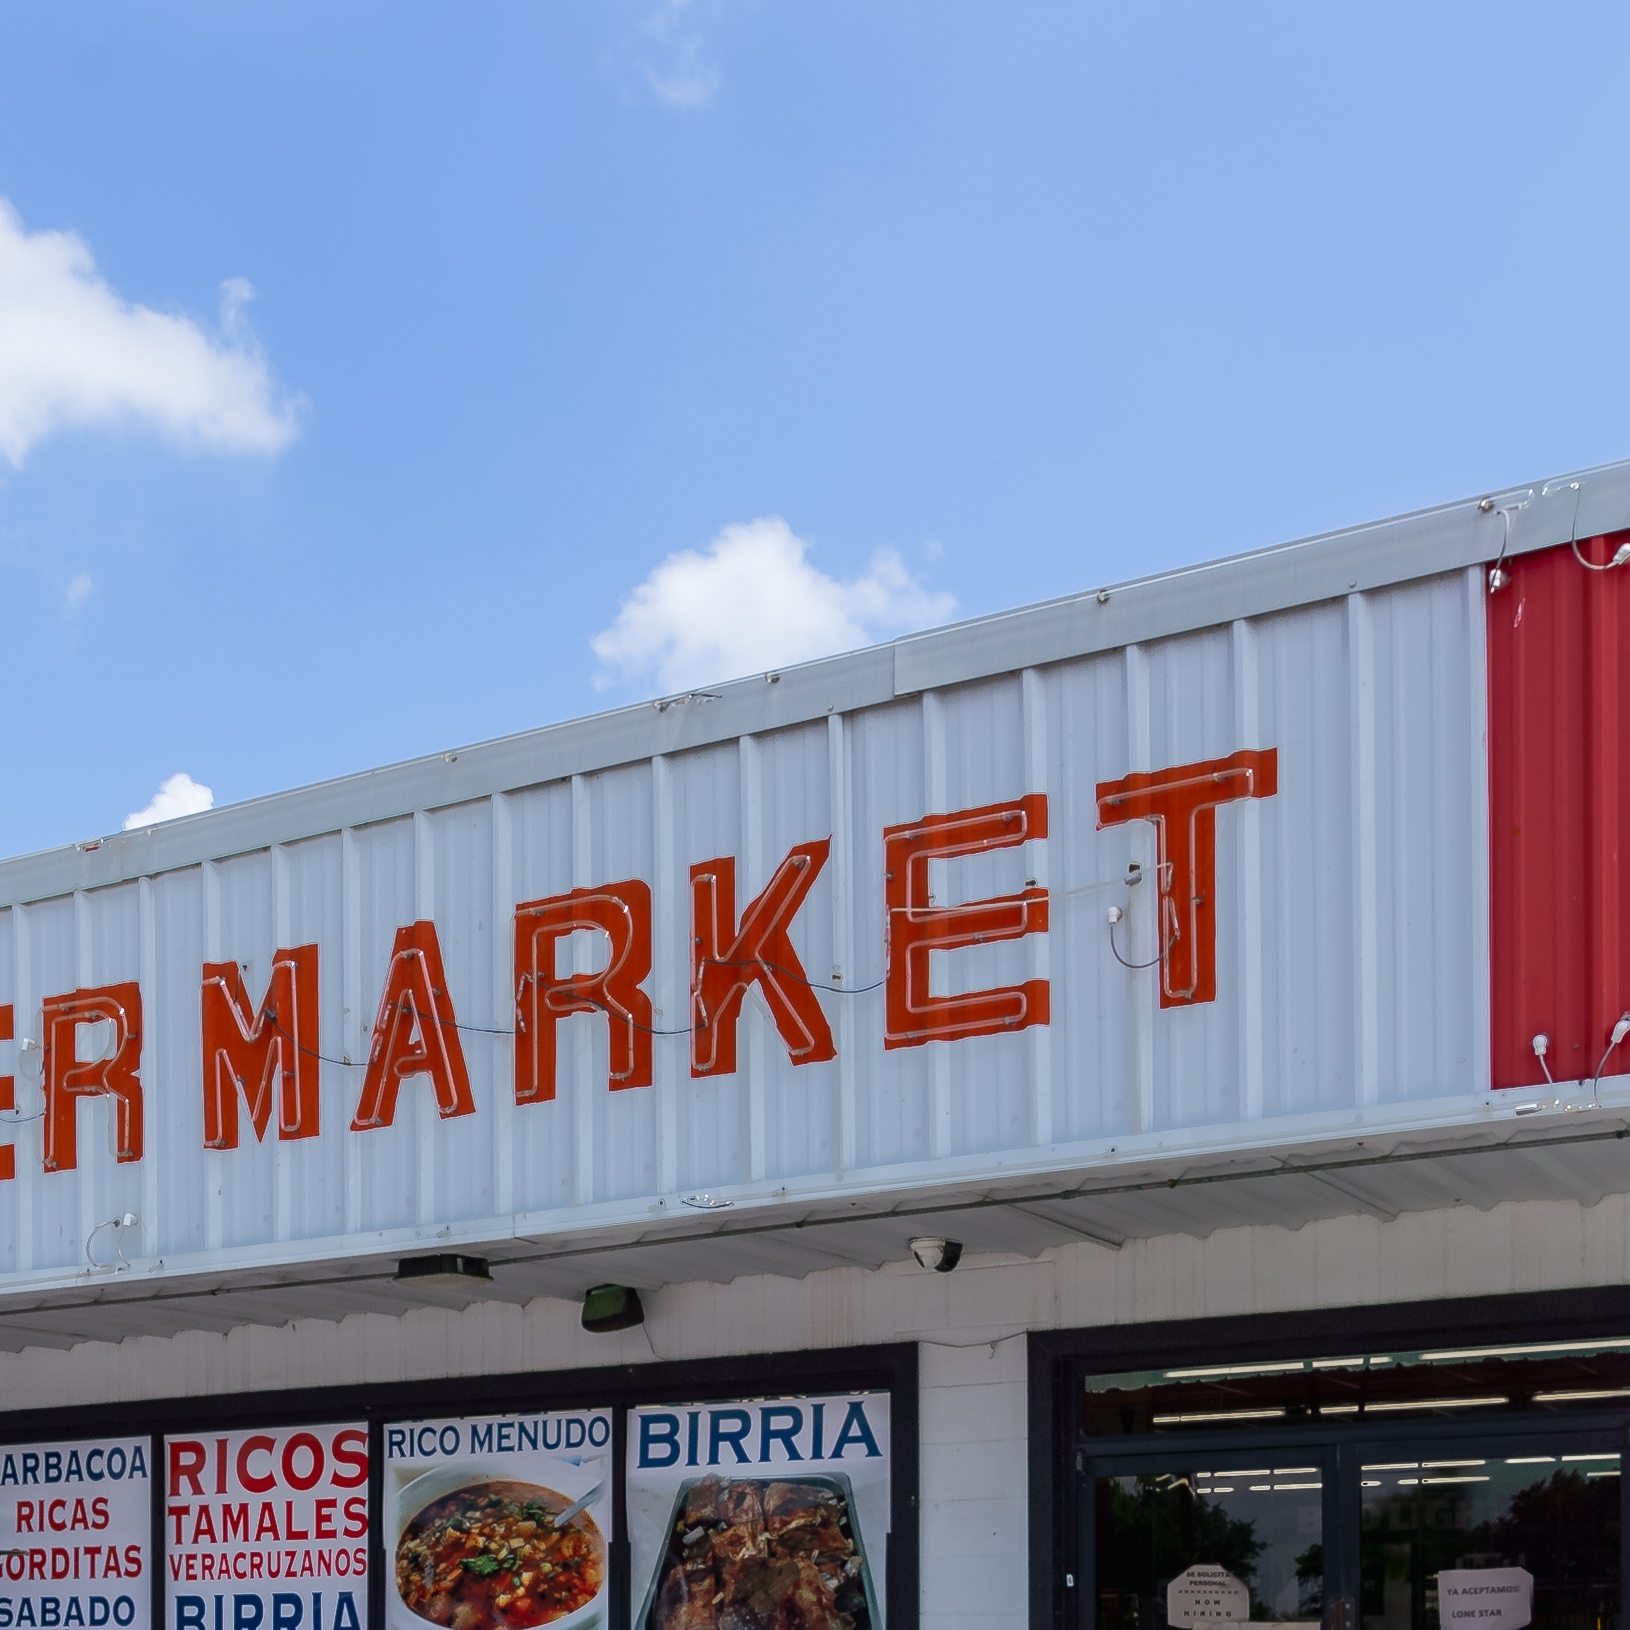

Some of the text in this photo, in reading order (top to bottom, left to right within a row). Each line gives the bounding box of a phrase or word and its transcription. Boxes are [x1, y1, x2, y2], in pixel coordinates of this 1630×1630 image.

[203, 748, 1278, 1150] MARKET
[387, 1415, 610, 1459] RICO MENUDO
[637, 1401, 883, 1469] BIRRIA
[168, 1430, 369, 1497] RICOS
[15, 1497, 109, 1533] RICAS
[168, 1496, 369, 1545] TAMALES
[168, 1547, 368, 1581] VERACRUZANOS
[1447, 1585, 1521, 1596] YA ACEPTAMOS
[1452, 1609, 1502, 1619] LONE STAR
